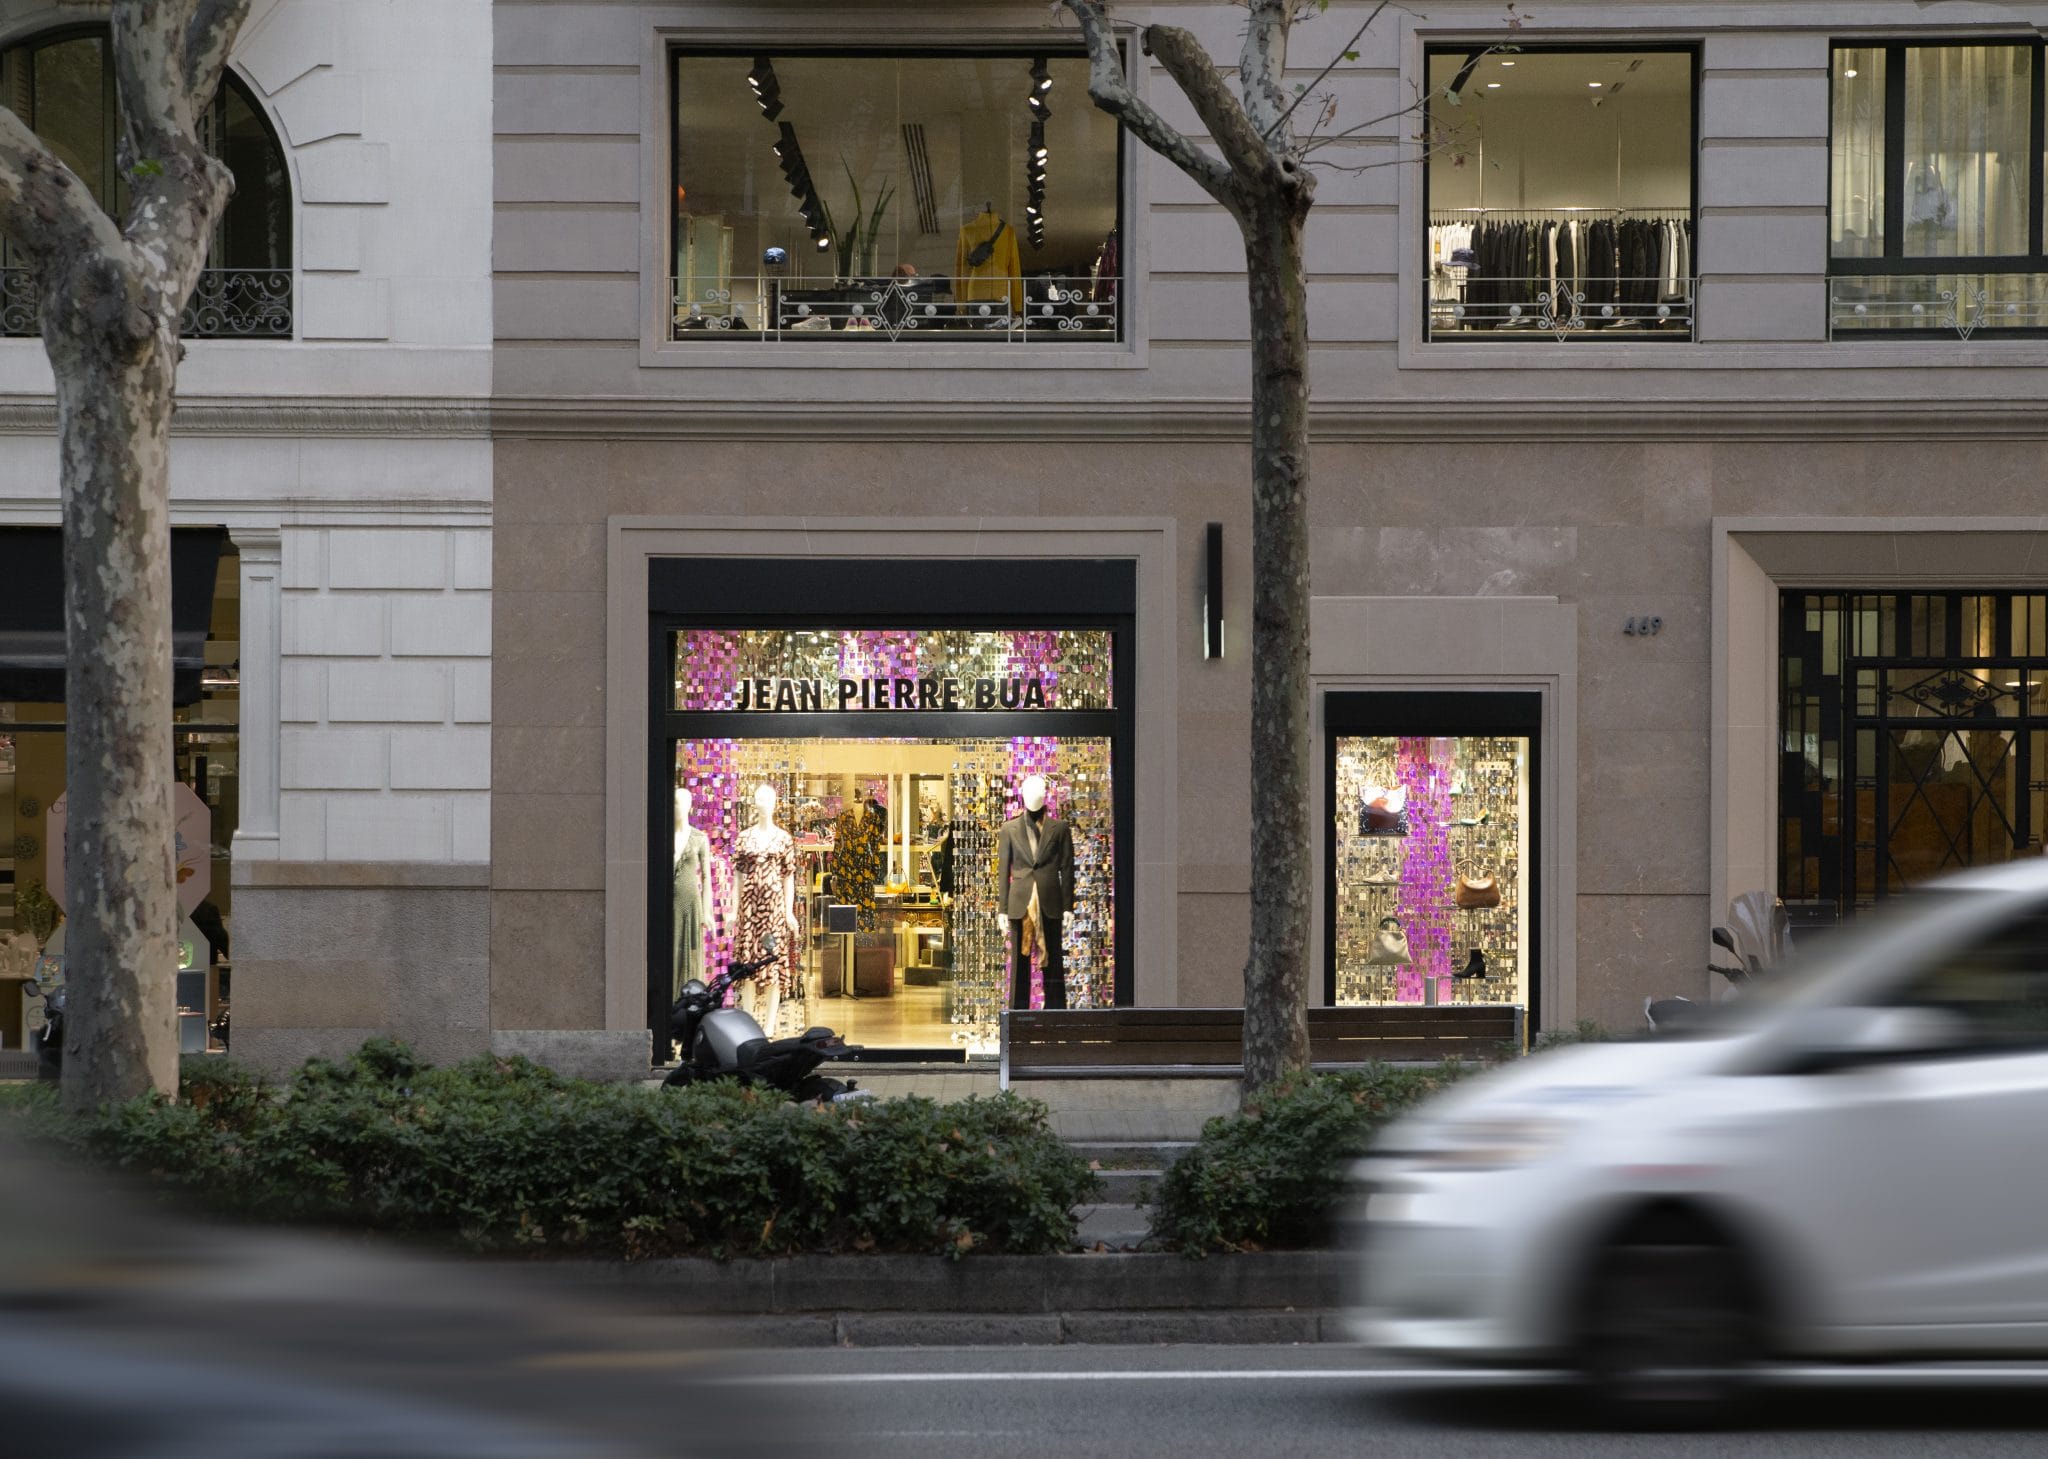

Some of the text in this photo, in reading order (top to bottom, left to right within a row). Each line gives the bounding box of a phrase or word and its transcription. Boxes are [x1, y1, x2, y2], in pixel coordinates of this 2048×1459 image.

[1623, 616, 1663, 636] 469
[738, 678, 1046, 710] JEAN PIERRE BUA
